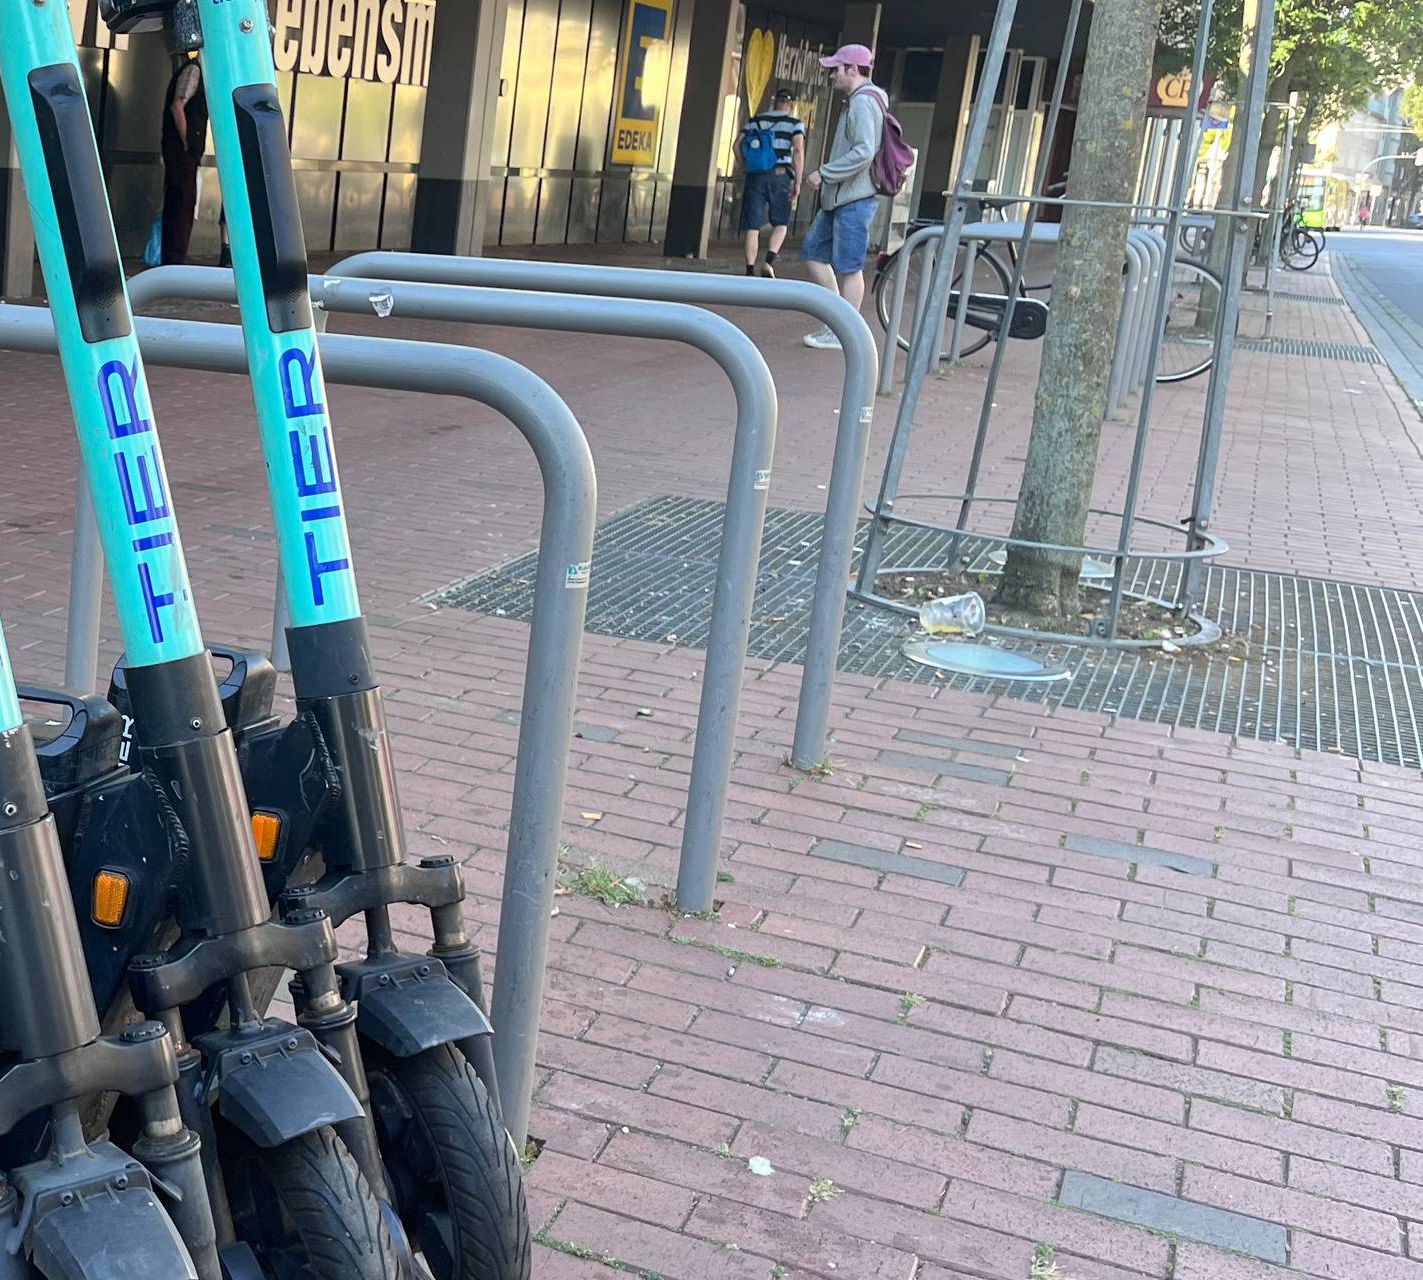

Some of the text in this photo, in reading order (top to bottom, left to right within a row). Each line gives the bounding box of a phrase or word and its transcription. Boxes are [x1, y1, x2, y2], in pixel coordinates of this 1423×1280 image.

[274, 0, 436, 87] ebensm
[617, 129, 652, 151] EDEKA
[97, 352, 185, 643] TIER
[279, 342, 349, 606] TIER
